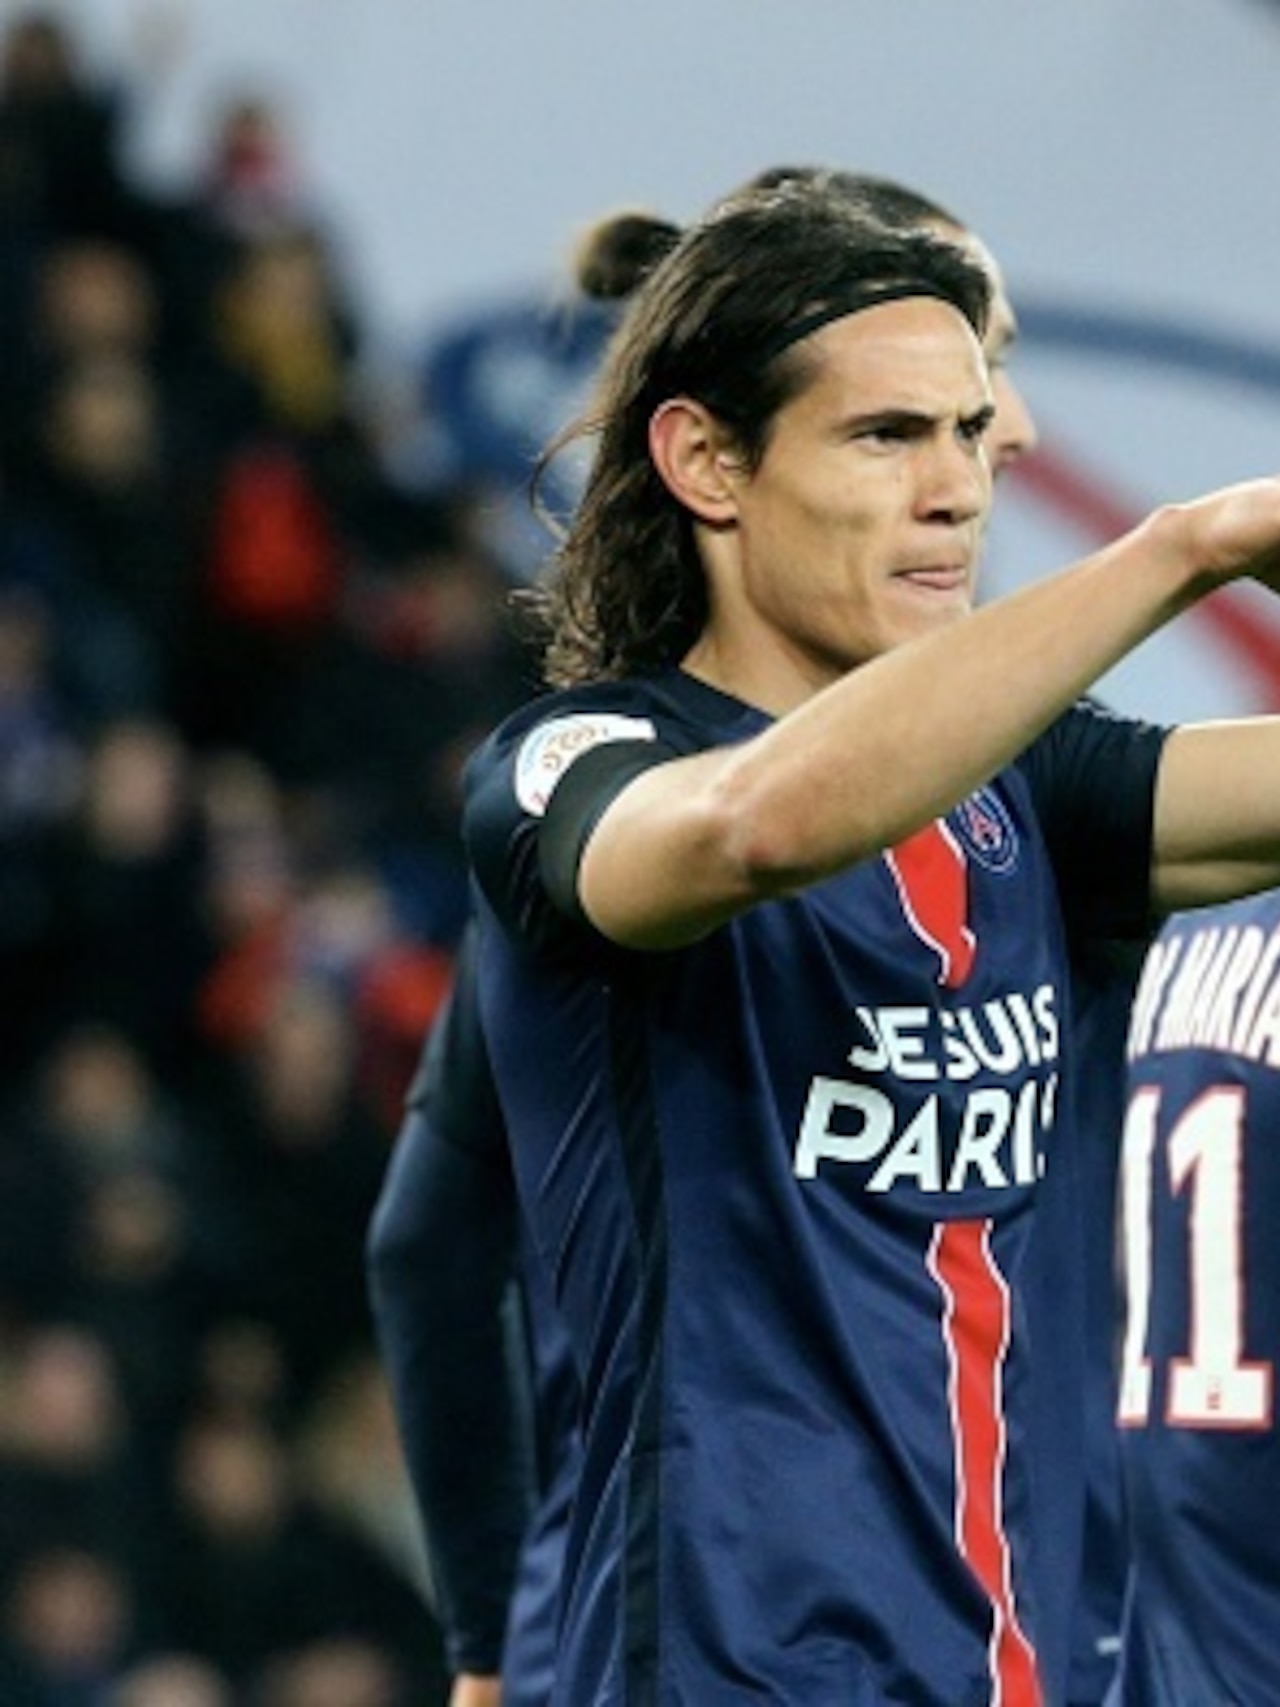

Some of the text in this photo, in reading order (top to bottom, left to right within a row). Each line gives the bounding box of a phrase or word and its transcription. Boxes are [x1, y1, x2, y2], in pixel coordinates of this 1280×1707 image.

[848, 984, 1059, 1080] JE SUIS
[1115, 1085, 1274, 1429] 11
